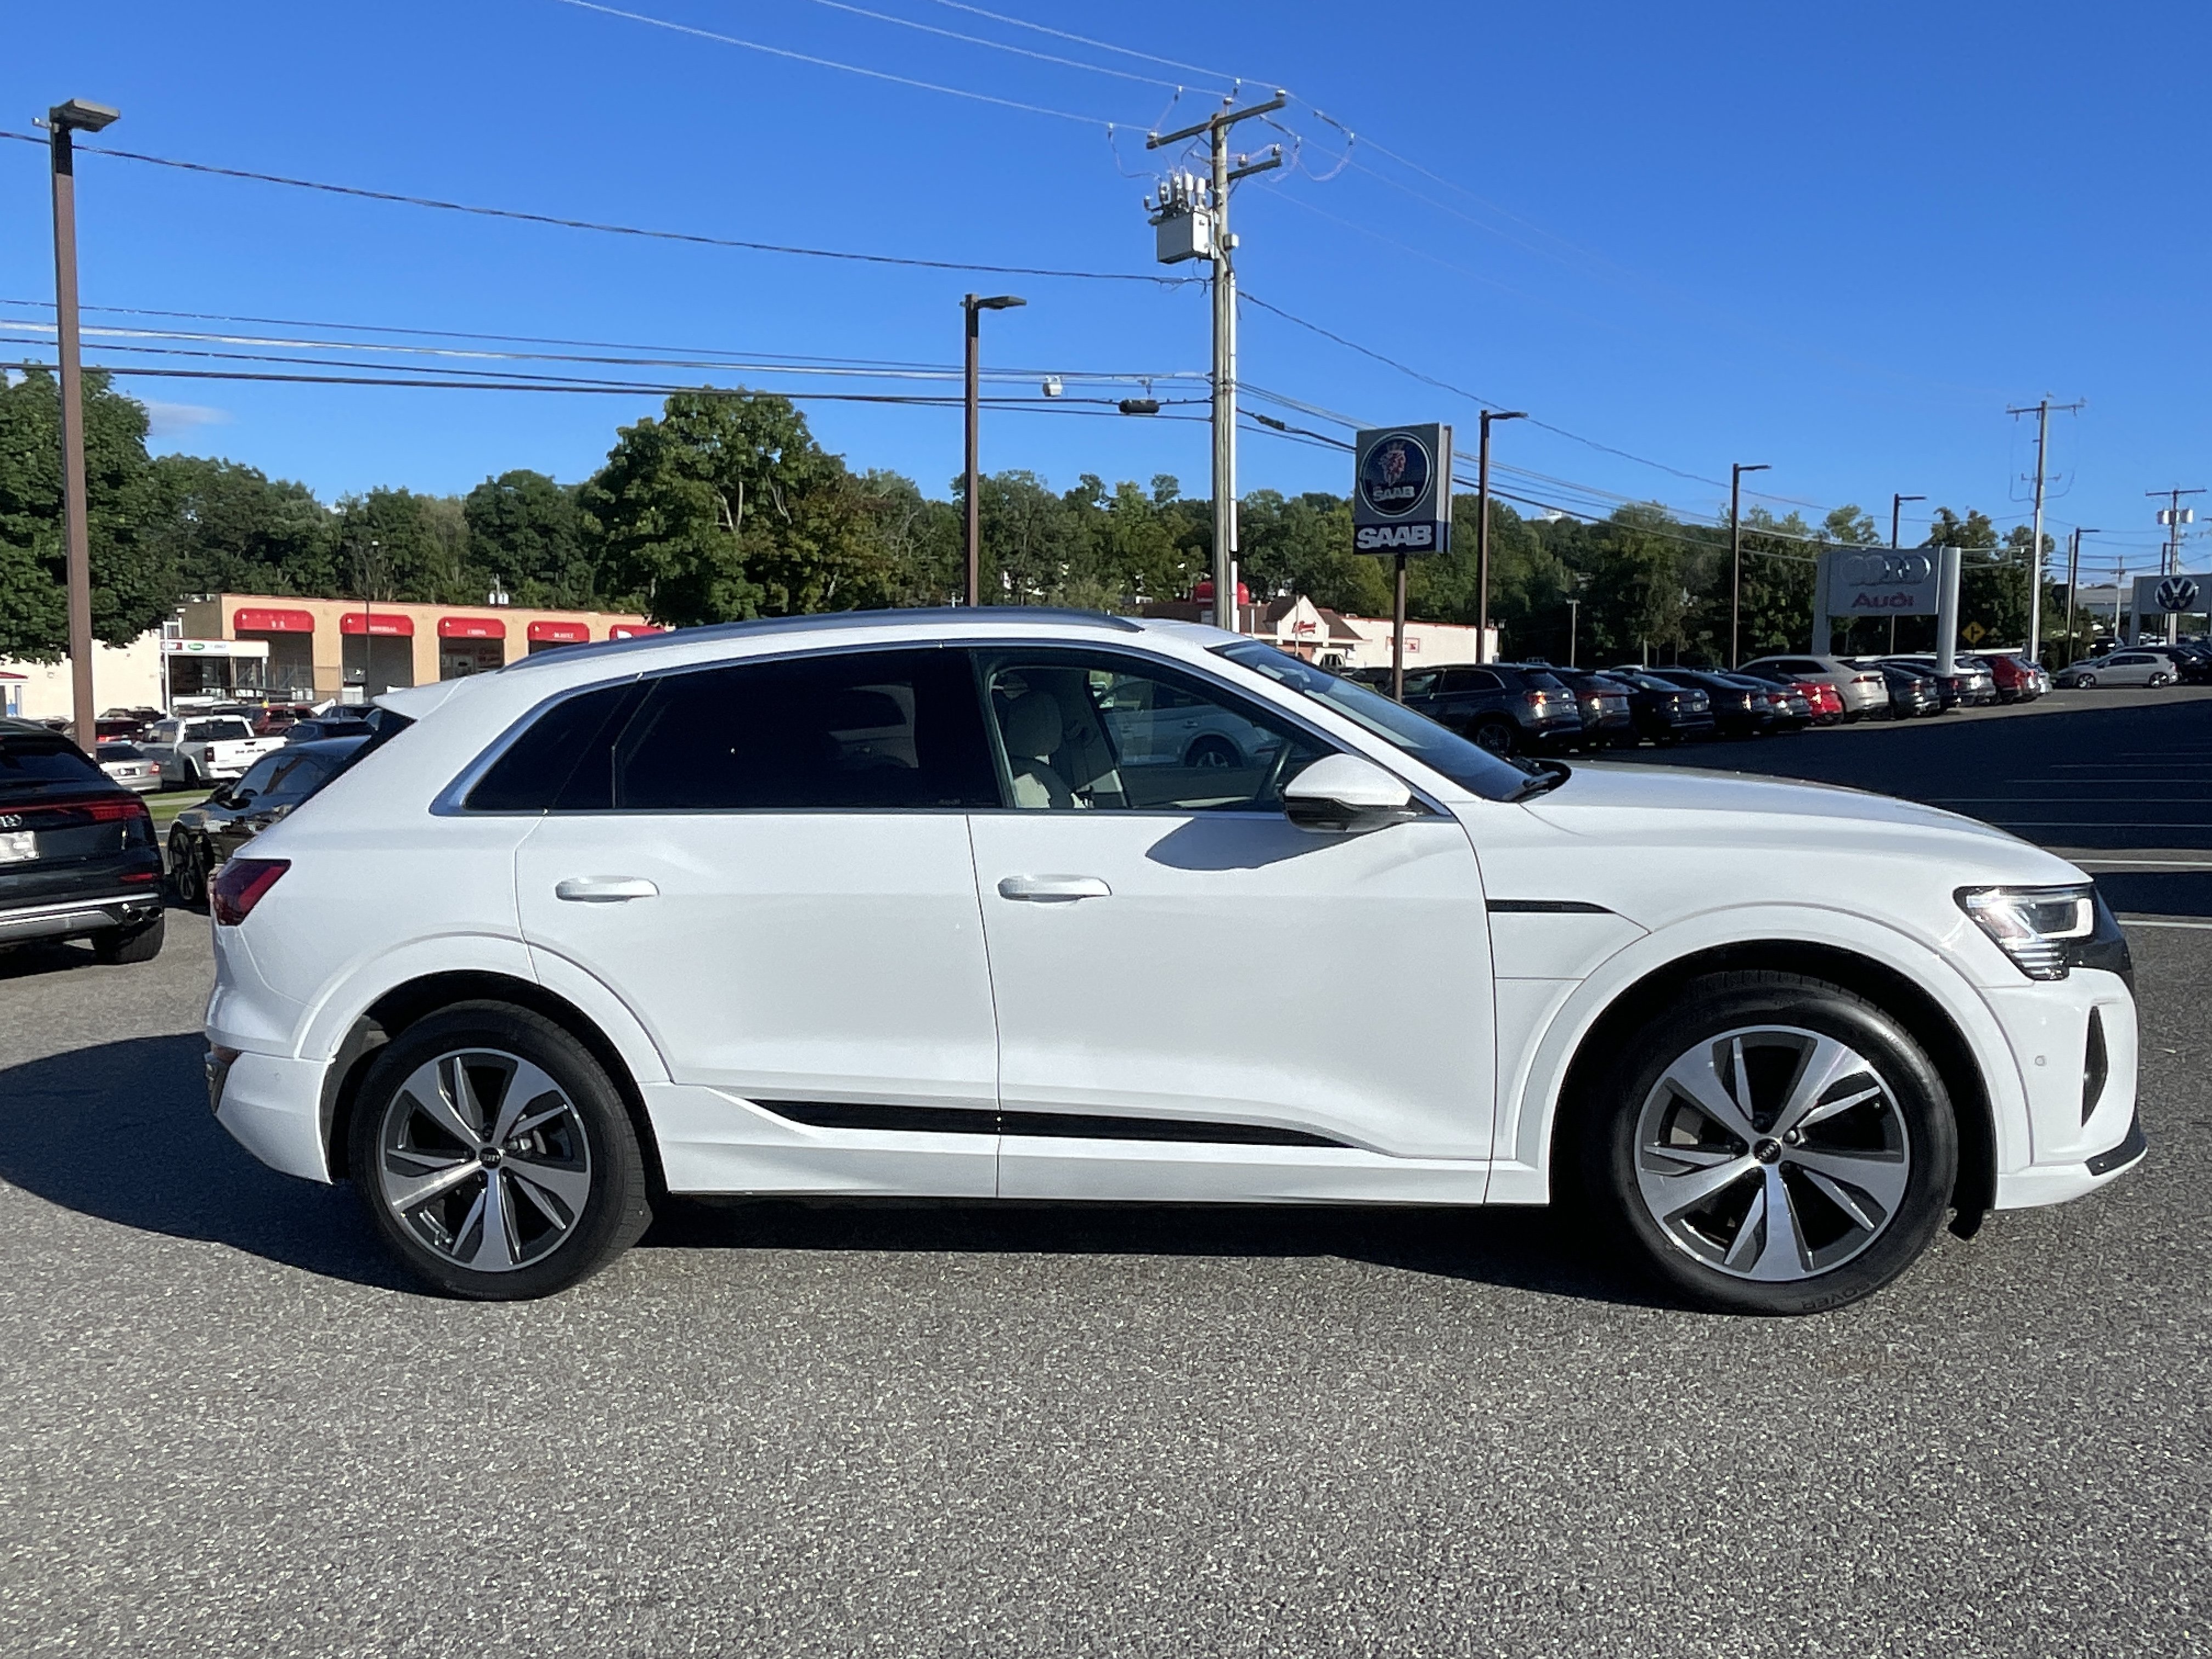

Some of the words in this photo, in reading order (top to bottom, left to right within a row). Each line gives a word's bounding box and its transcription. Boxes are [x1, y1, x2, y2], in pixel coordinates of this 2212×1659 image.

[1373, 486, 1415, 501] SAAB
[1357, 525, 1432, 549] SAAB
[1851, 592, 1914, 608] Audi
